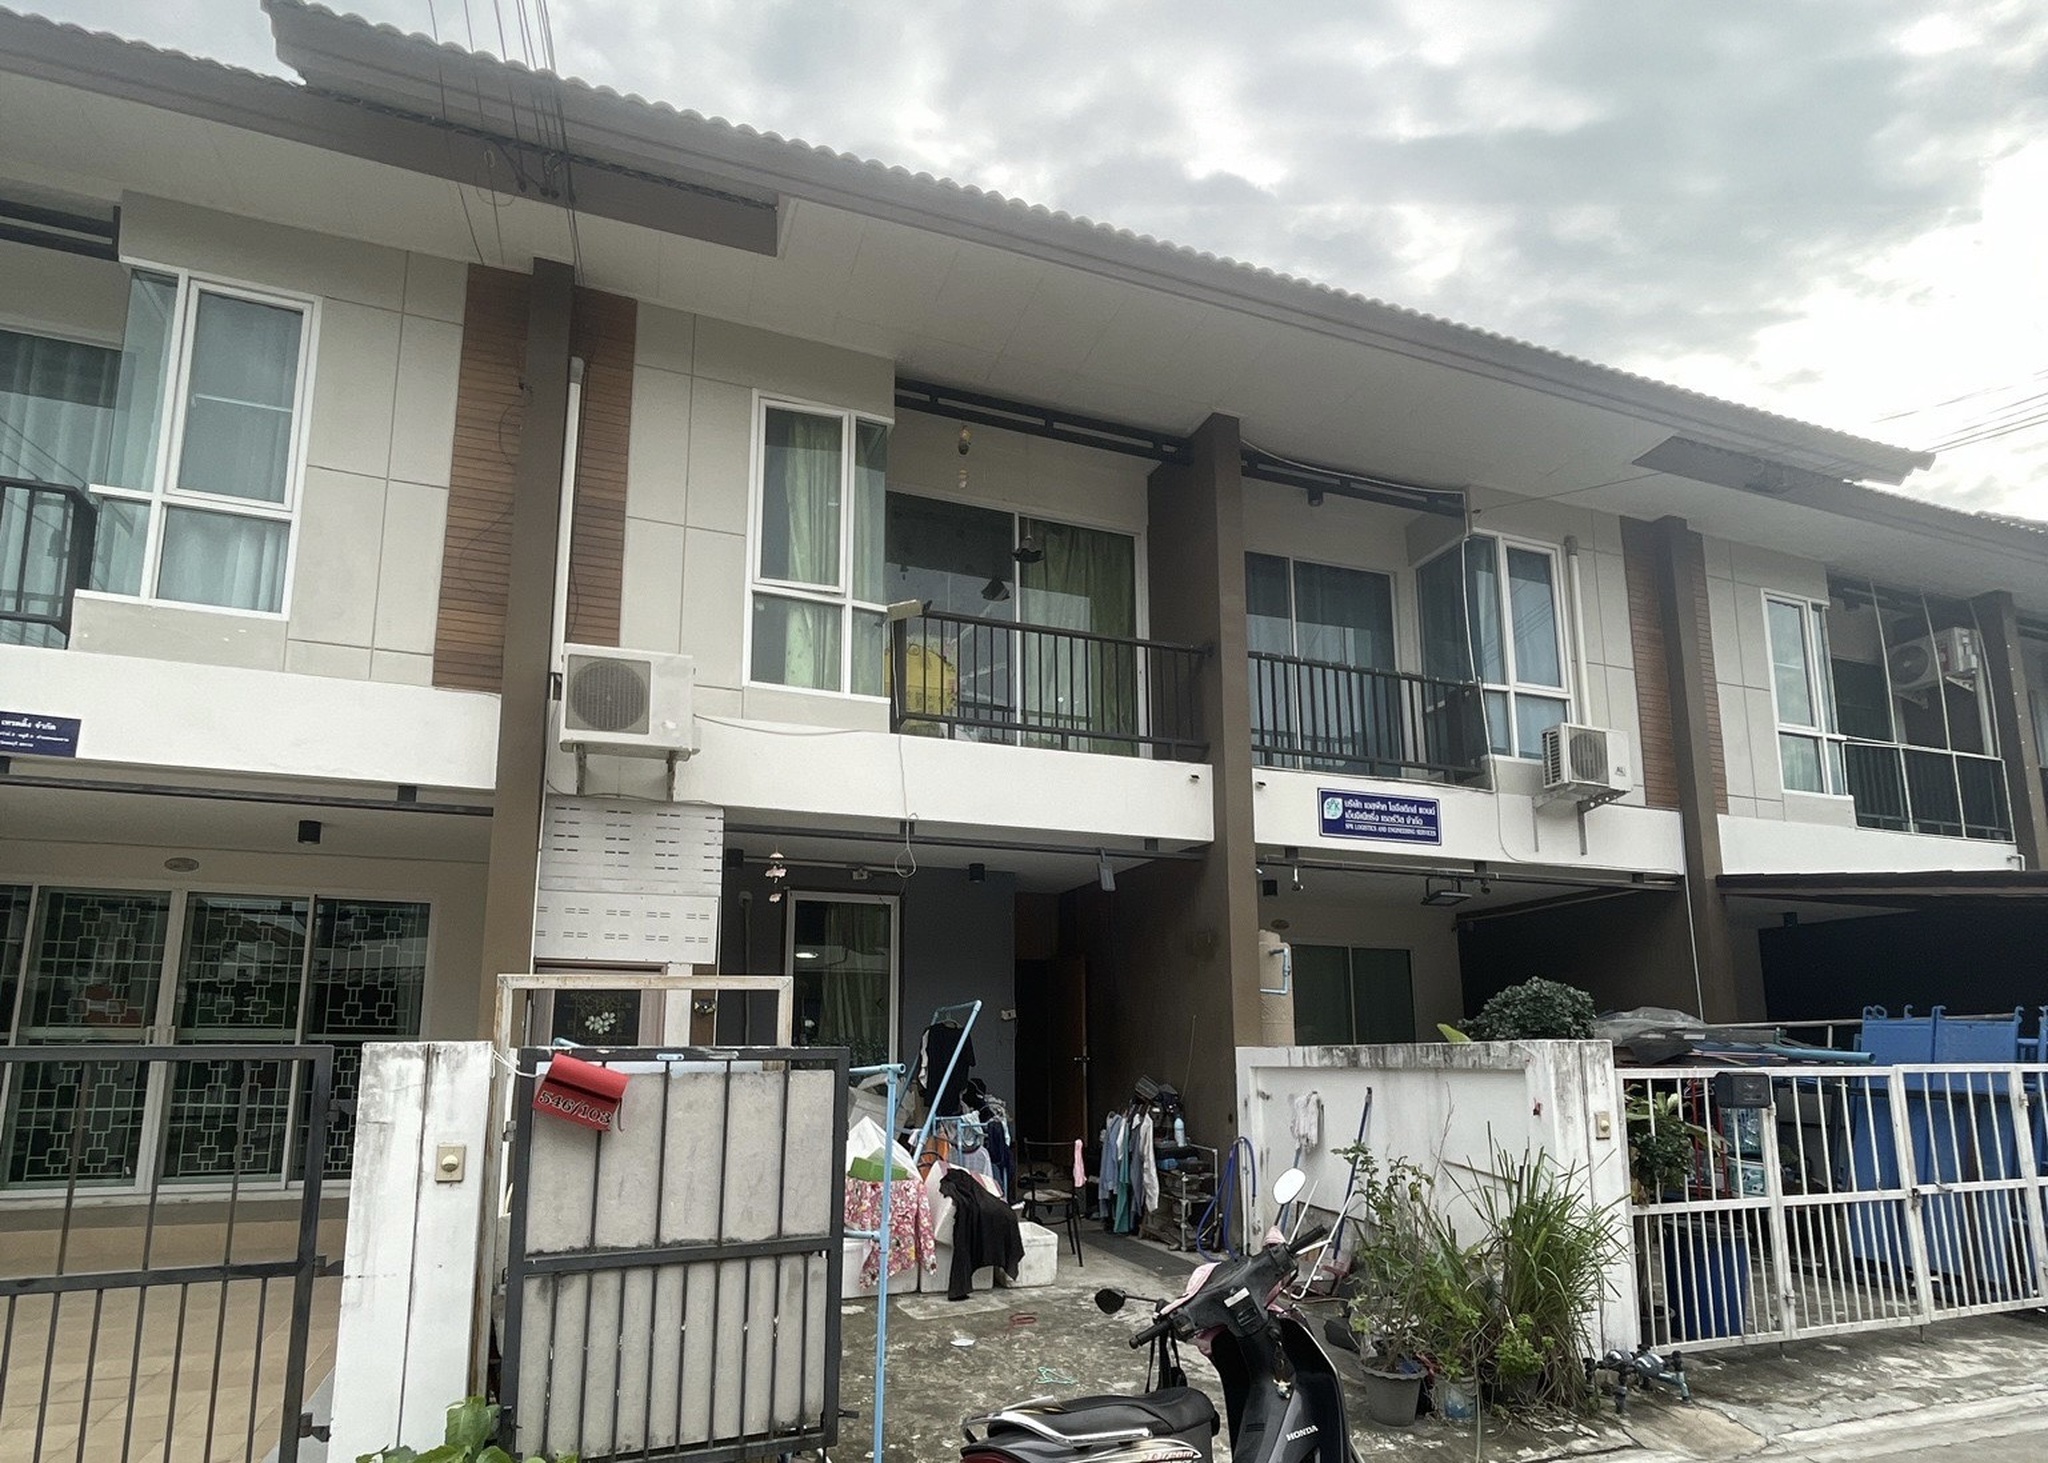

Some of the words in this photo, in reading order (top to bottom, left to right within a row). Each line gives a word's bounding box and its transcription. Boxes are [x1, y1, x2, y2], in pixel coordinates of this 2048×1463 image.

[35, 720, 56, 730] จำกัด
[1344, 799, 1363, 809] บริษัท
[1406, 815, 1424, 825] จำกัด
[1354, 823, 1377, 832] LOGISTICS
[1388, 826, 1416, 835] ENGINEERING
[537, 1090, 613, 1125] 546/103
[1286, 1424, 1319, 1441] HONDA
